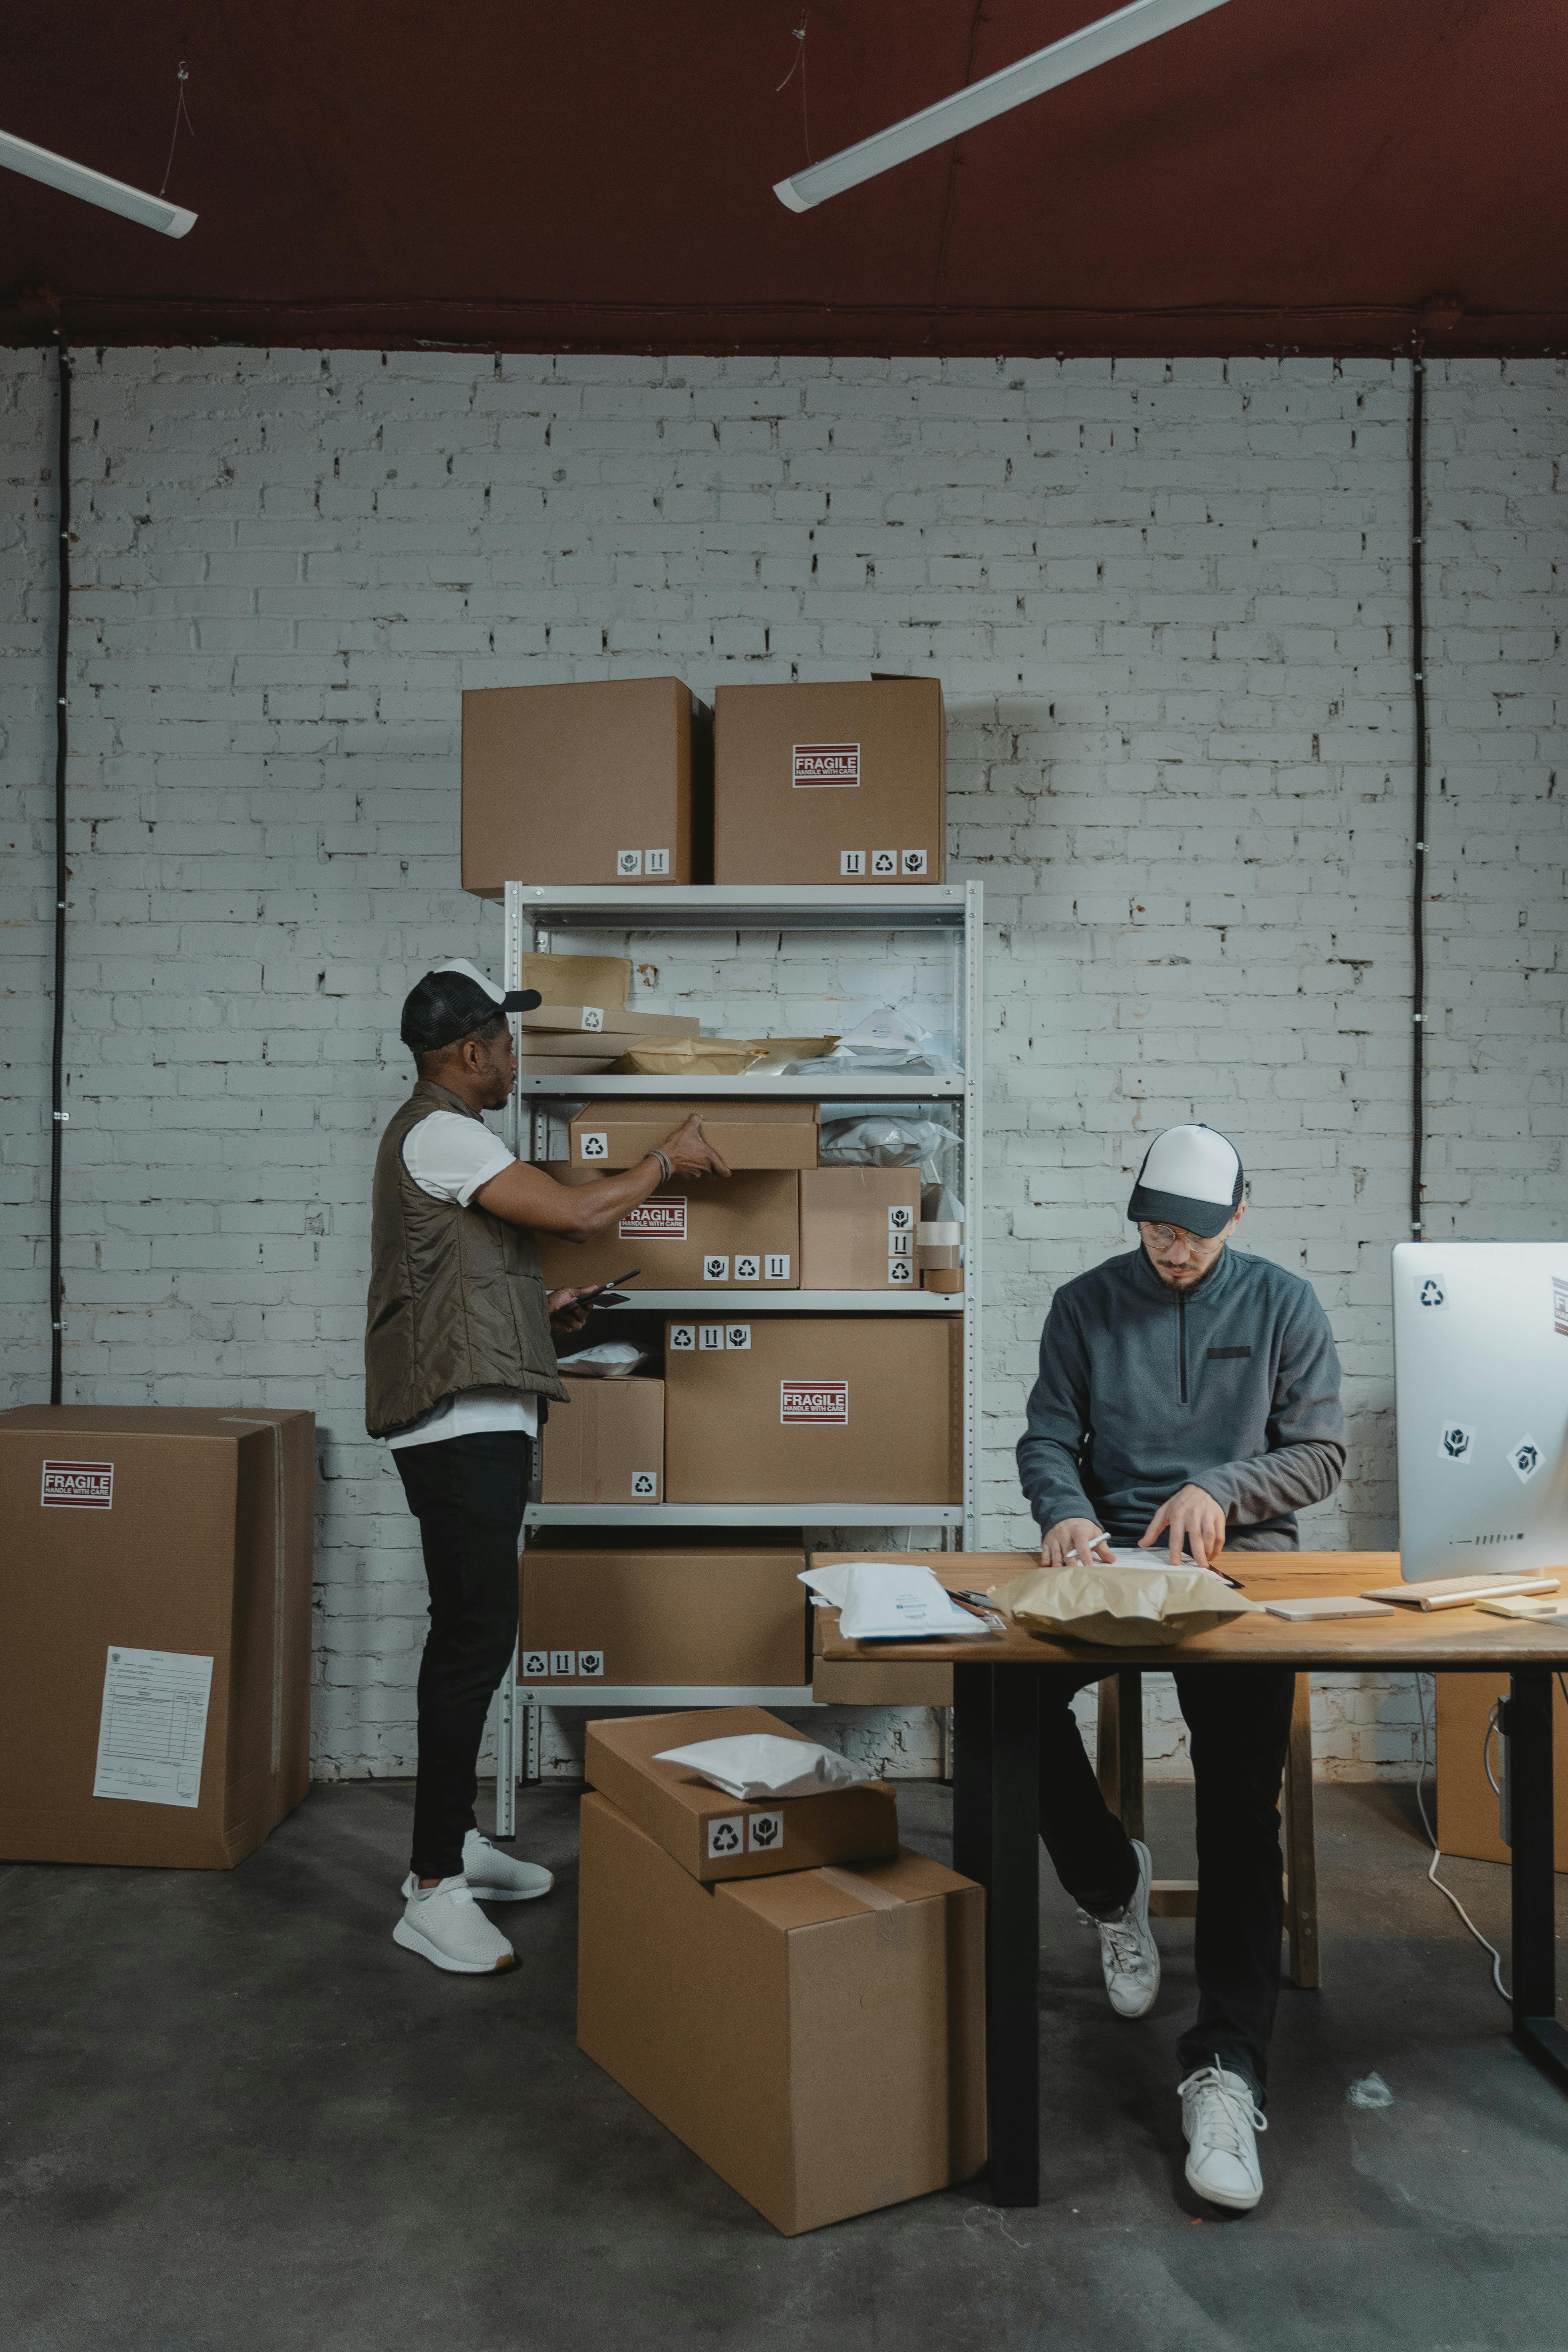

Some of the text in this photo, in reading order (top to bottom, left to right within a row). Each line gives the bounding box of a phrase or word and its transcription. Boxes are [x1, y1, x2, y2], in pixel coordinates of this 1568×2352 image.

[796, 757, 857, 769] FRAGILE
[622, 1209, 683, 1221] RAGILE
[784, 1394, 845, 1406] FRAGILE
[45, 1475, 110, 1490] FRAGILE
